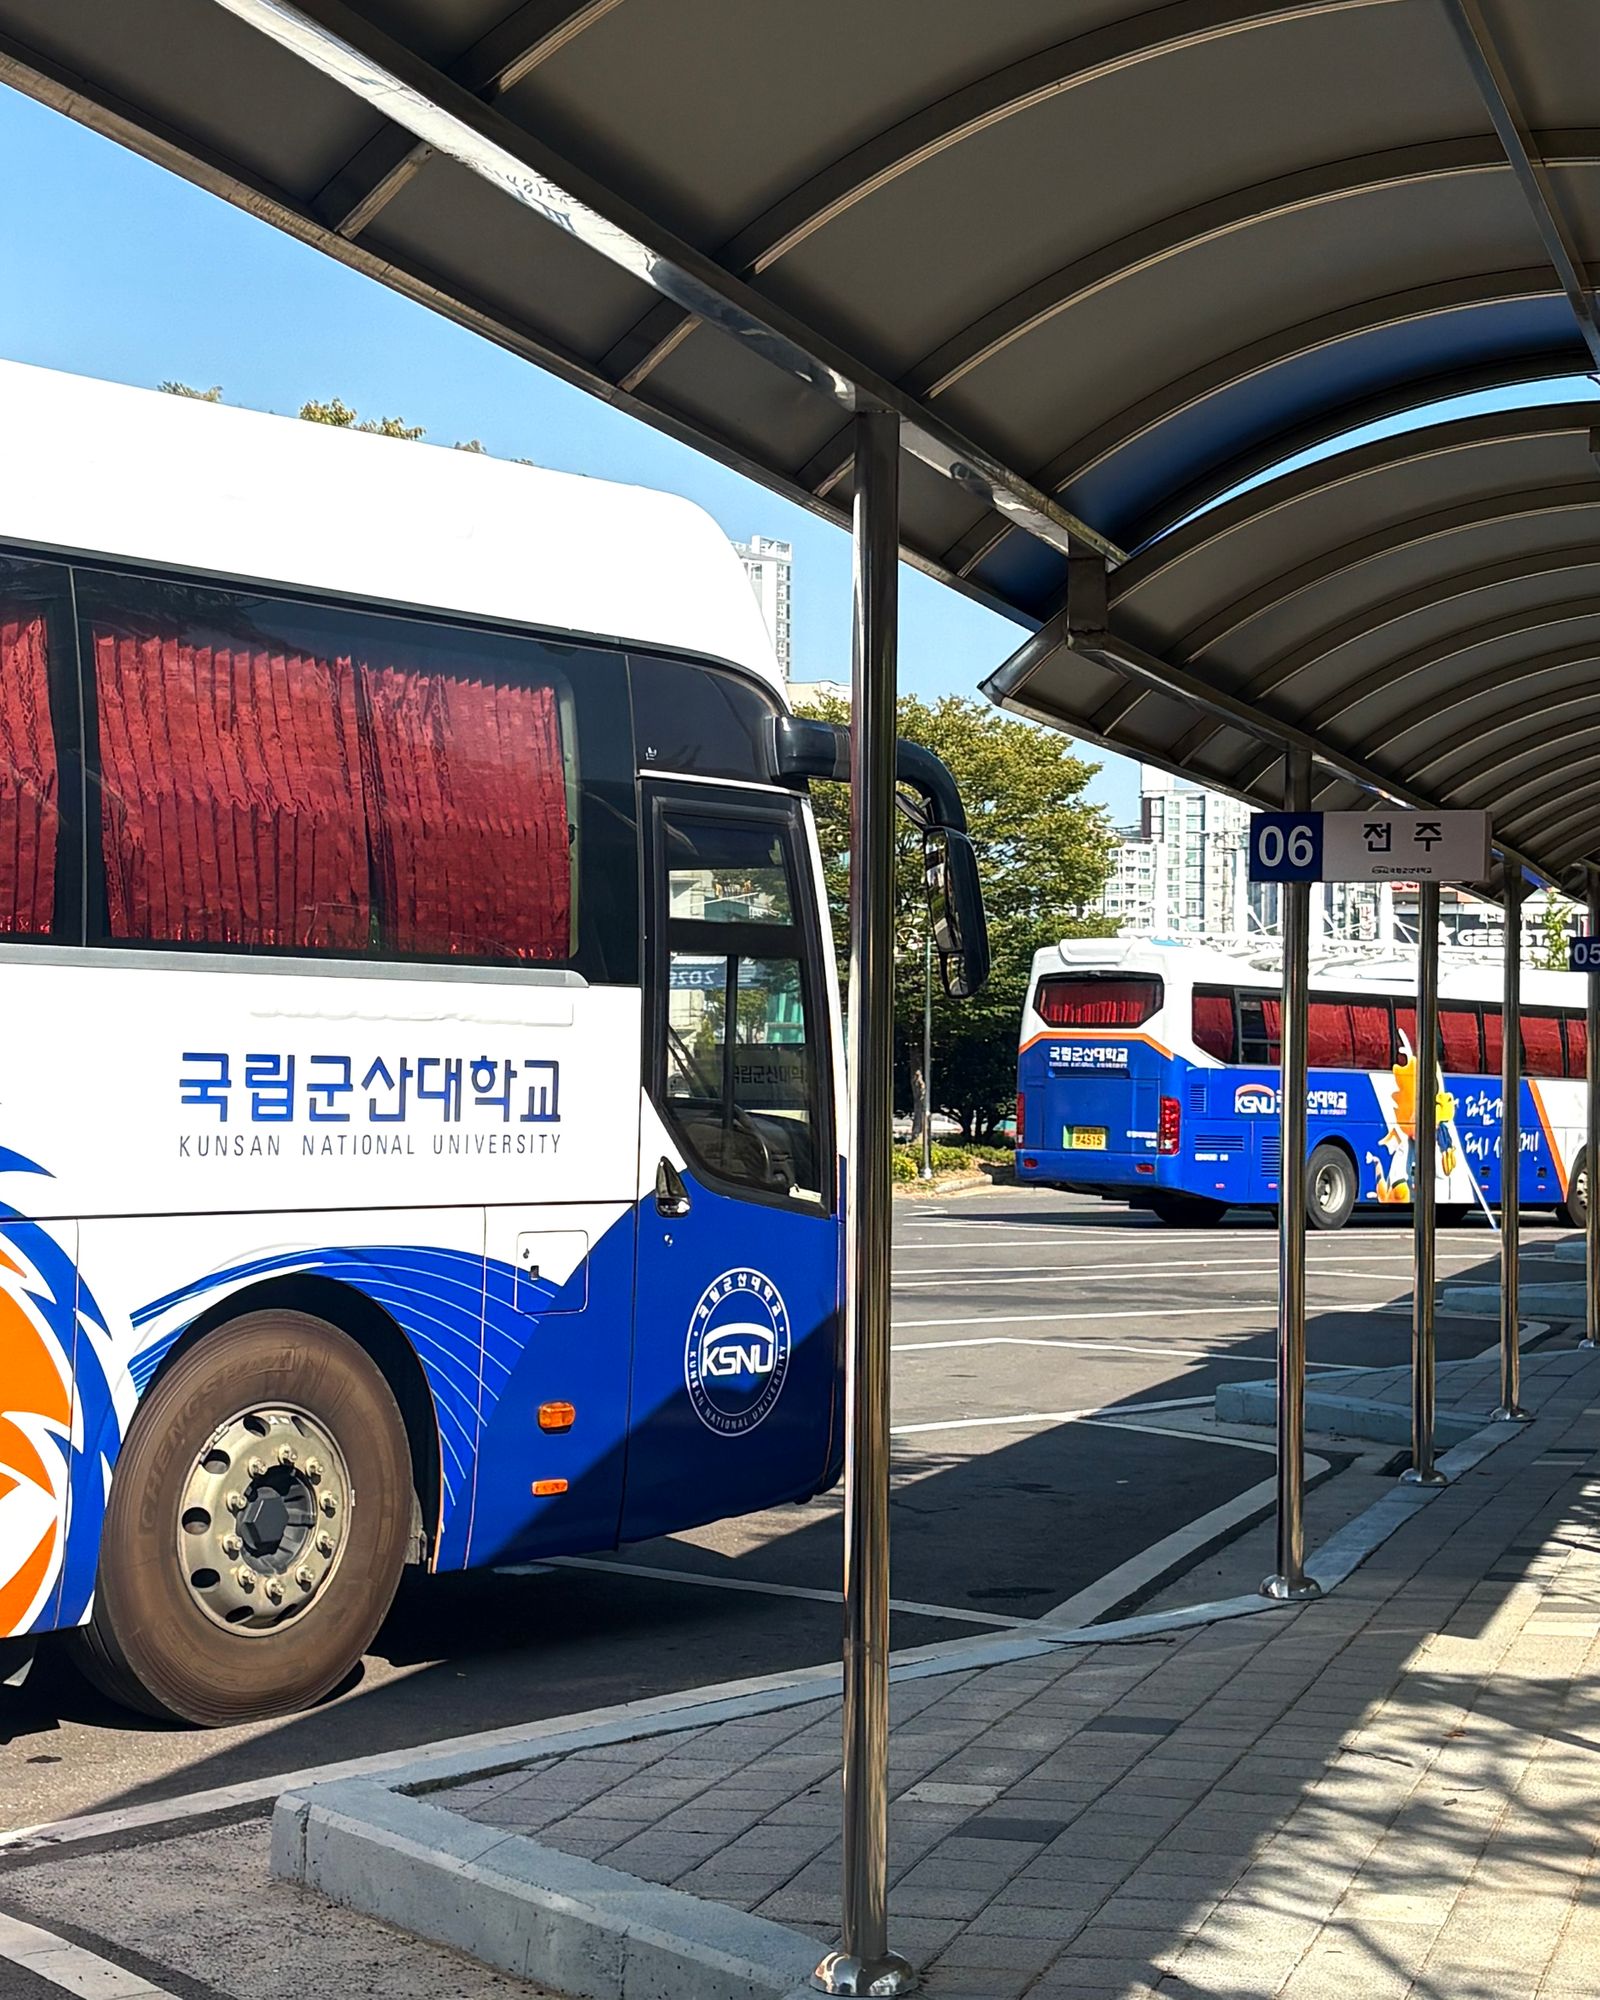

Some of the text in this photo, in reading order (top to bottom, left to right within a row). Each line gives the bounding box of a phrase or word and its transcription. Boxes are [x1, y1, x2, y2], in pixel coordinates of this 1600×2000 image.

[1258, 825, 1314, 867] 06
[1574, 943, 1600, 964] 05
[1049, 1047, 1128, 1062] 국립군산대학교
[179, 1052, 561, 1122] 국립군산대학교
[1235, 1095, 1275, 1113] KSNU
[179, 1133, 562, 1157] KUNSAN NATIONAL UNIVERSITY
[702, 1344, 774, 1377] KSNU
[704, 1407, 749, 1430] NATIONAL
[752, 1345, 787, 1421] UNIVERSITY
